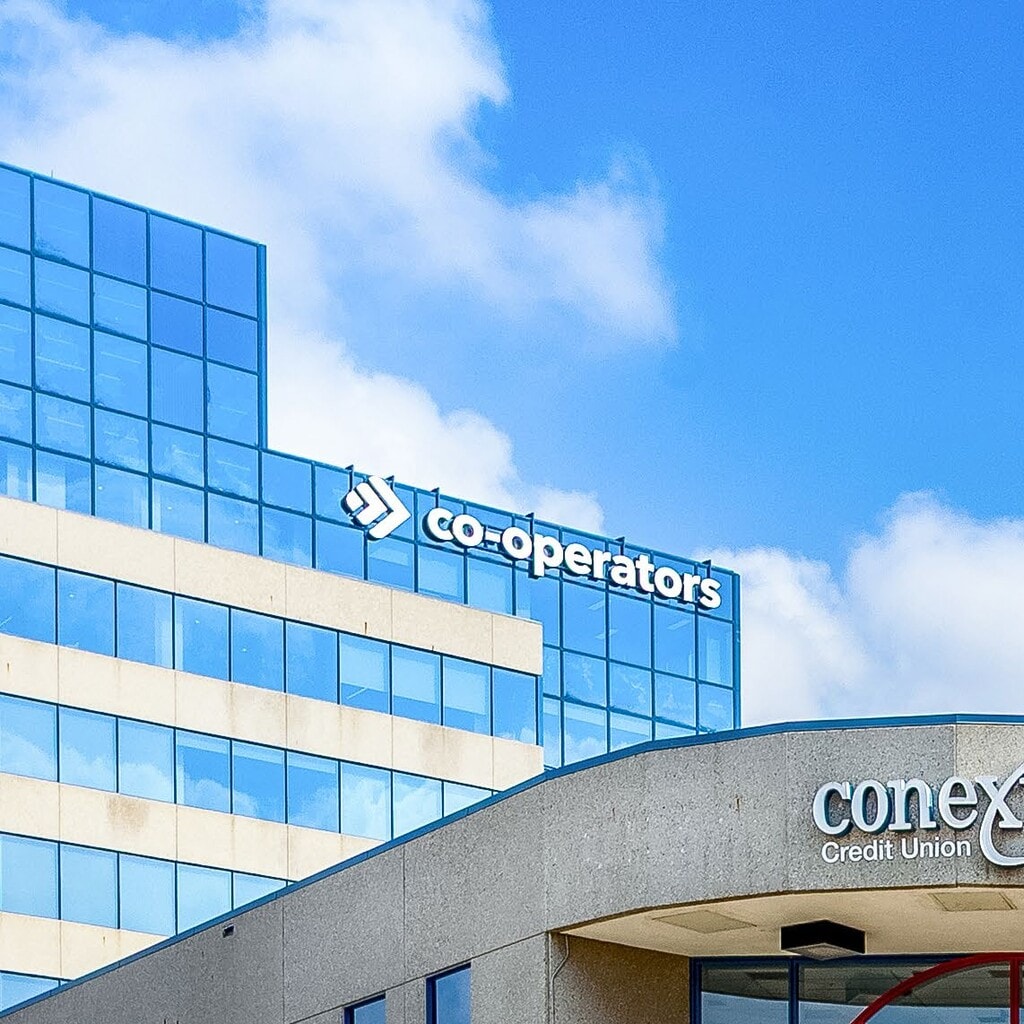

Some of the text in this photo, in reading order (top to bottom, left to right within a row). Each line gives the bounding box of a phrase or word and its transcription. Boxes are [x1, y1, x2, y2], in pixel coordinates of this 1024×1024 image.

[424, 507, 721, 609] co-operators
[821, 837, 971, 863] Credit Union
